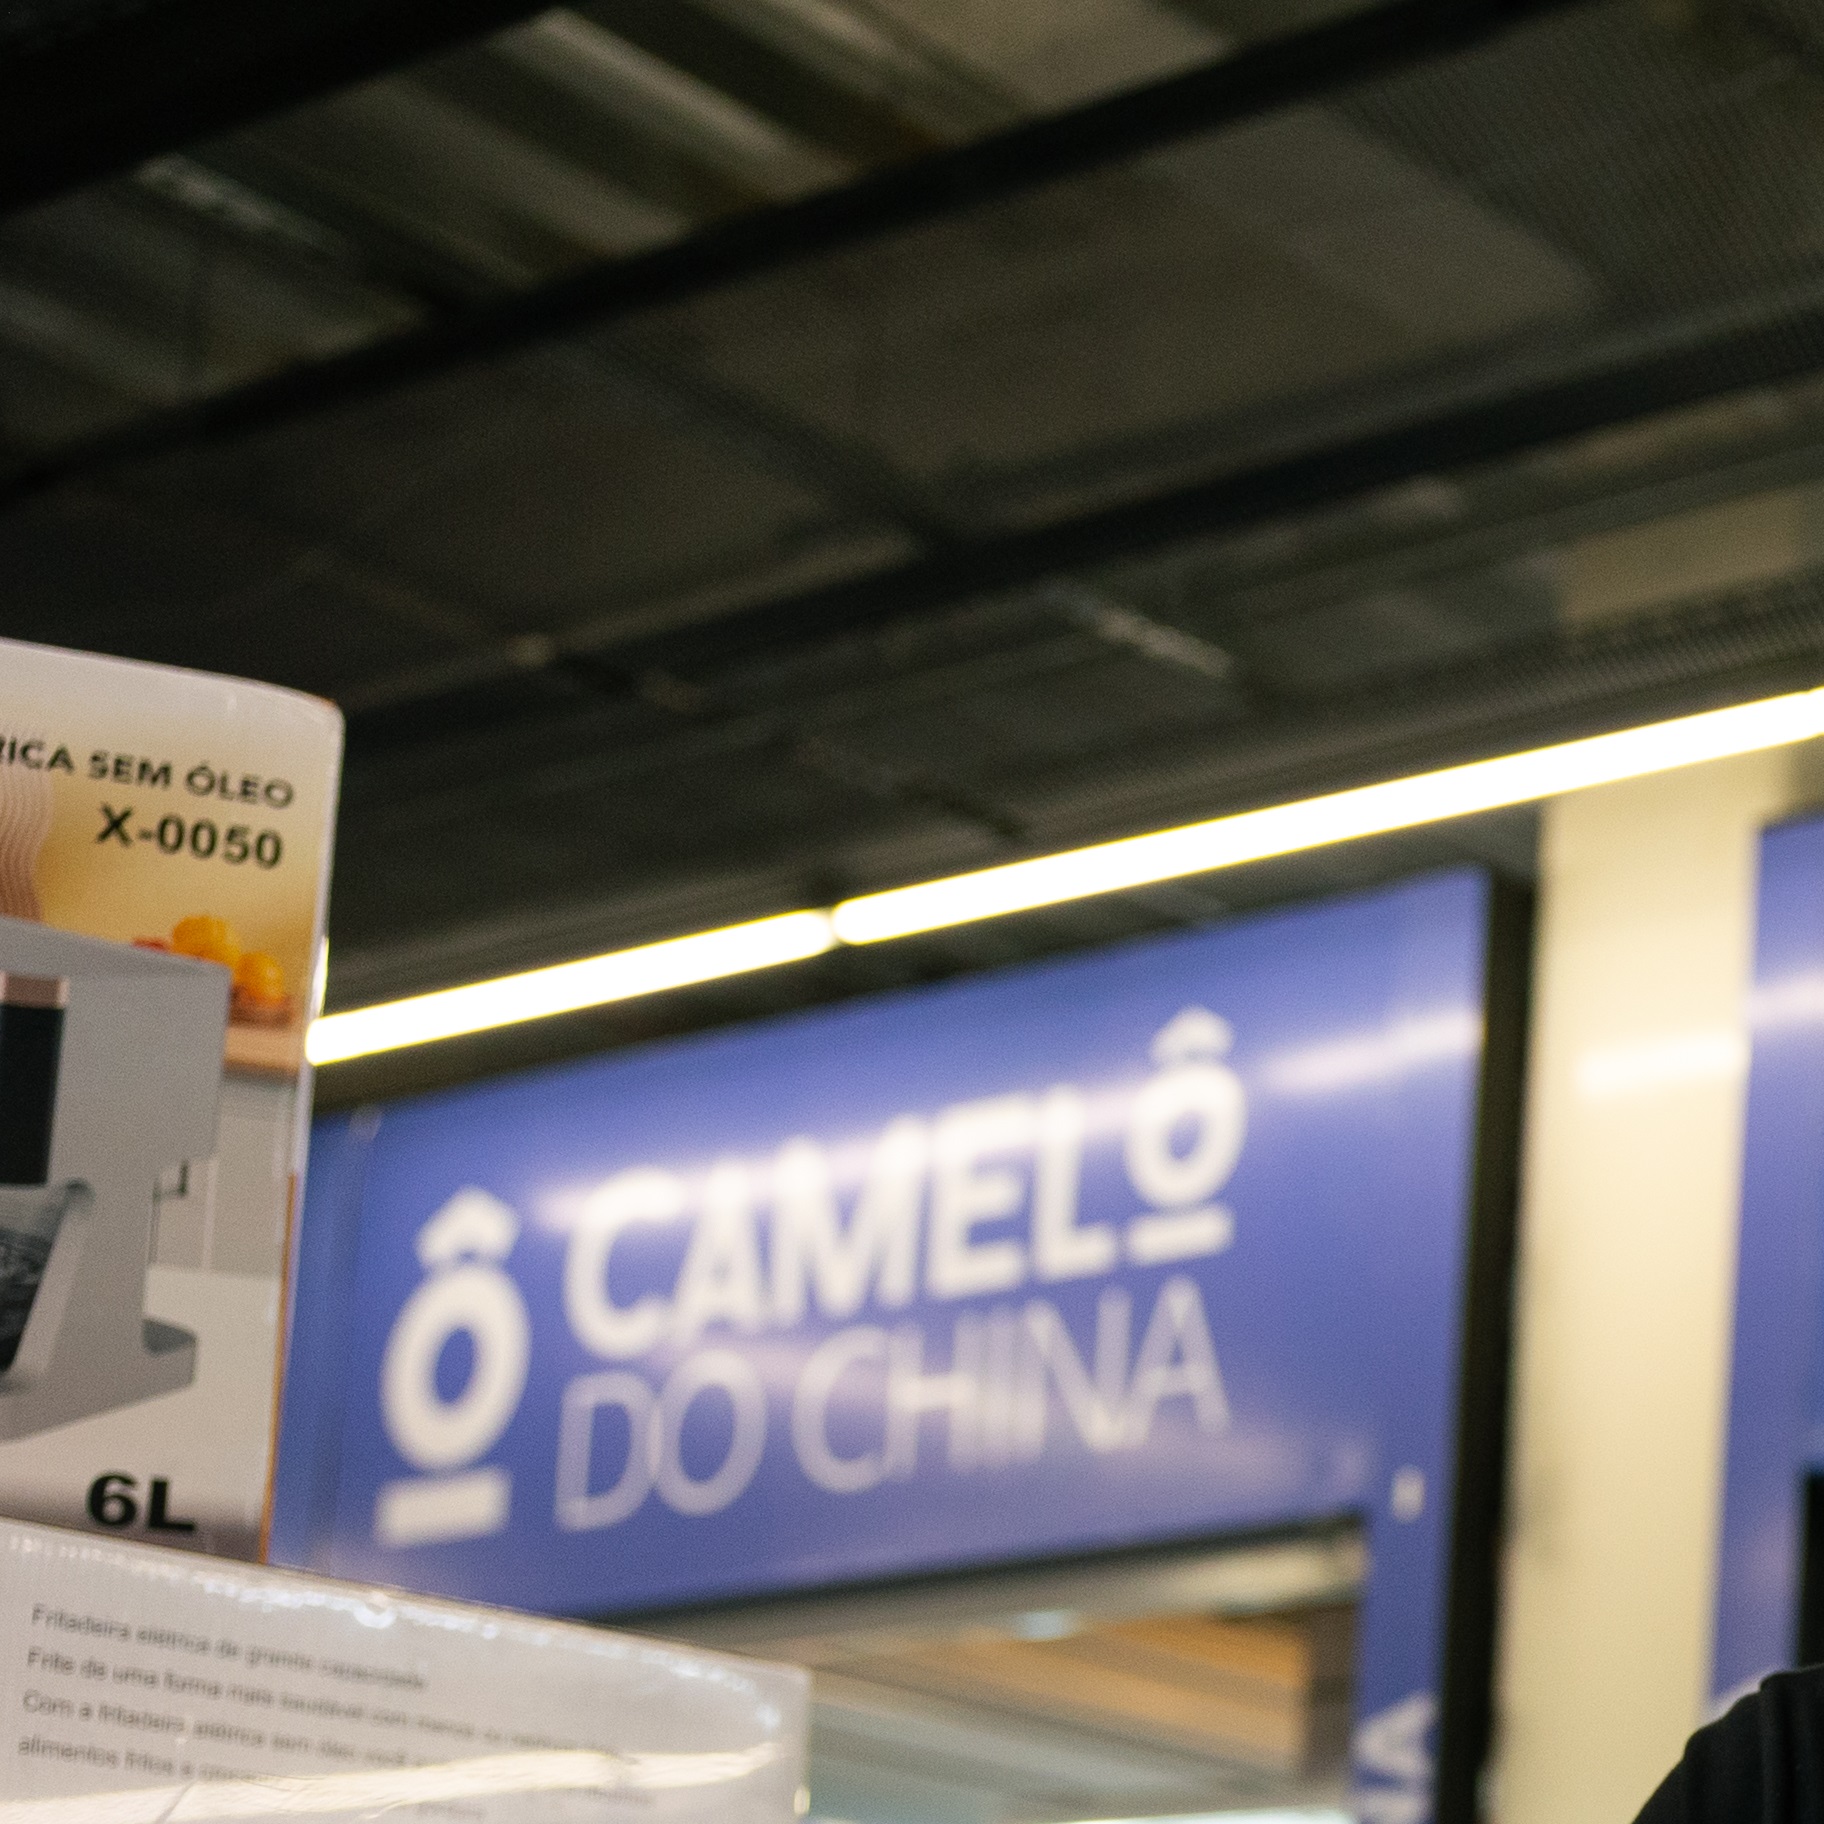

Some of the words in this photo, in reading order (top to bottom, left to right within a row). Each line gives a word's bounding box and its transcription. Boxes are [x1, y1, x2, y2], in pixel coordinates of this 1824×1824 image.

[88, 750, 173, 791] SEM
[184, 760, 294, 809] ÓLEO
[95, 803, 284, 871] X-0050
[563, 1007, 1247, 1359] CAMELÔ
[555, 1346, 768, 1532] DO
[793, 1276, 1232, 1494] CHINA
[86, 1469, 197, 1533] 6L
[31, 1602, 131, 1640] Fritadeira
[22, 1689, 75, 1716] Com
